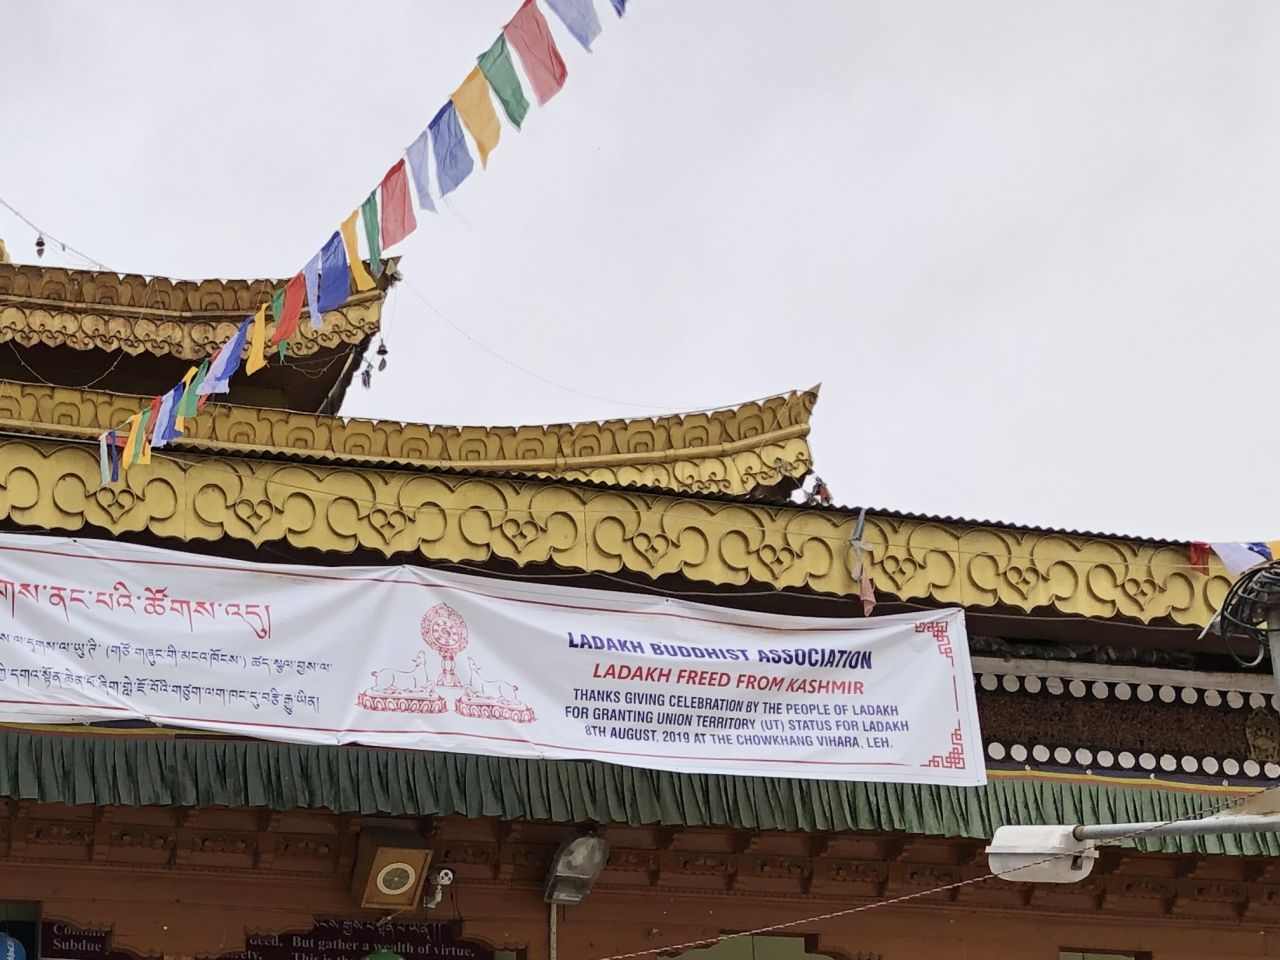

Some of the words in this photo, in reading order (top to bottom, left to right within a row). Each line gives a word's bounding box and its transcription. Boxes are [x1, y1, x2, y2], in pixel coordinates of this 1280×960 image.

[568, 631, 644, 654] LADAKH
[650, 642, 749, 661] BUDDHIST
[758, 647, 872, 670] ASSOCIATION
[593, 663, 672, 683] LADAKH
[676, 669, 730, 688] FREED
[736, 673, 785, 691] FROM
[786, 678, 864, 695] KASHMIR
[573, 688, 620, 704] THANKS
[625, 692, 664, 706] GIVING
[669, 695, 743, 712] CELEBRATION
[746, 699, 760, 712] BY
[762, 701, 783, 714] THE
[786, 703, 830, 716] PEOPLE
[834, 704, 850, 716] OF
[852, 703, 898, 716] LADAKH
[565, 706, 590, 720] FOR
[593, 707, 652, 725] GRANTING
[657, 713, 693, 727] UNION
[696, 715, 756, 730] TERRITORY
[760, 718, 785, 733] (UT)
[789, 719, 832, 732] STATUS
[835, 719, 859, 732] FOR
[862, 719, 909, 733] LADAKH
[585, 724, 607, 737] 8TH
[610, 725, 659, 743] AUGUST,
[663, 729, 690, 743] 2019
[694, 730, 708, 743] AT
[709, 732, 733, 744] THE
[736, 732, 813, 747] CHOWKHANG
[816, 734, 863, 749] VIHARA,
[866, 734, 893, 748] LEH.
[53, 938, 102, 952] Subdue
[292, 936, 314, 948] But
[319, 939, 359, 951] gather
[362, 943, 370, 951] a
[418, 944, 431, 955] of
[434, 944, 475, 957] virtue,
